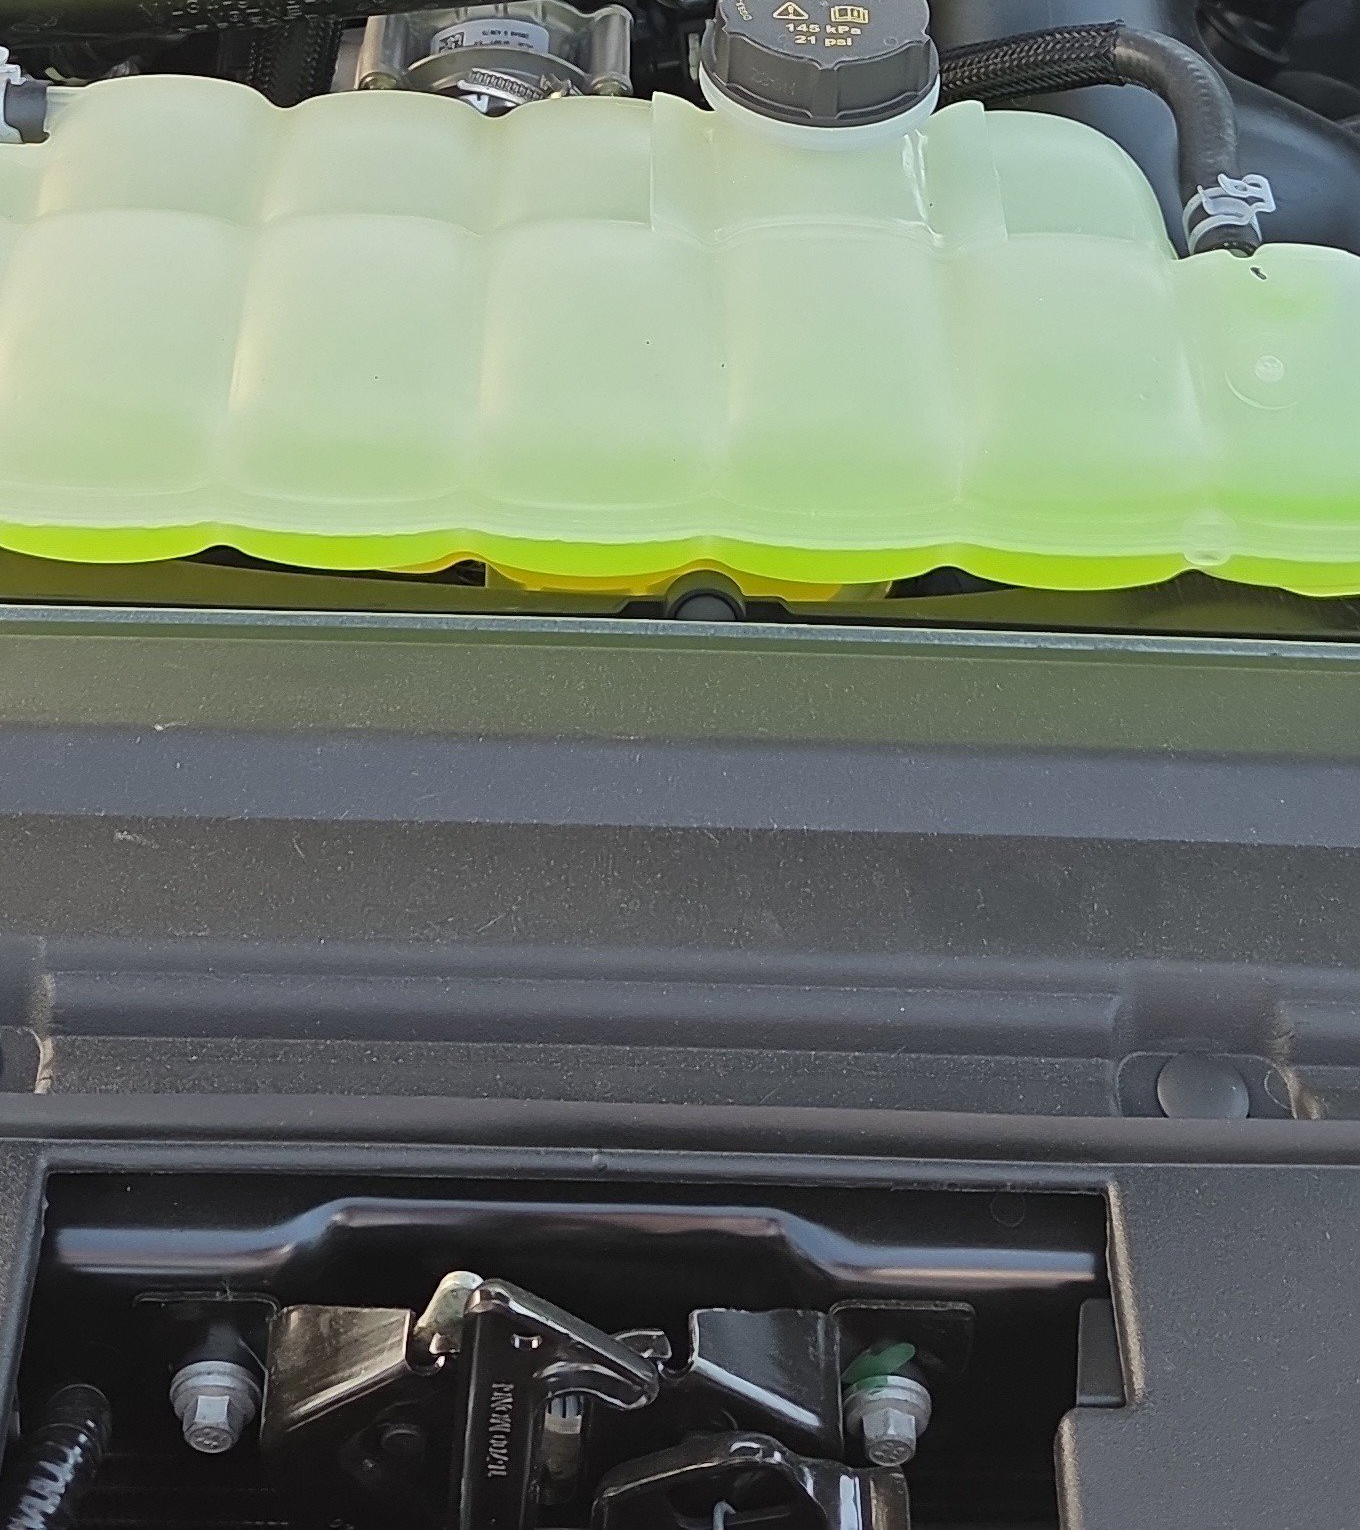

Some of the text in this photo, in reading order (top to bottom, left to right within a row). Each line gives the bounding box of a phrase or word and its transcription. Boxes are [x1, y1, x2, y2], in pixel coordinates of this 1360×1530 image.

[785, 22, 863, 36] 145 kPa
[794, 34, 853, 48] 21 psi
